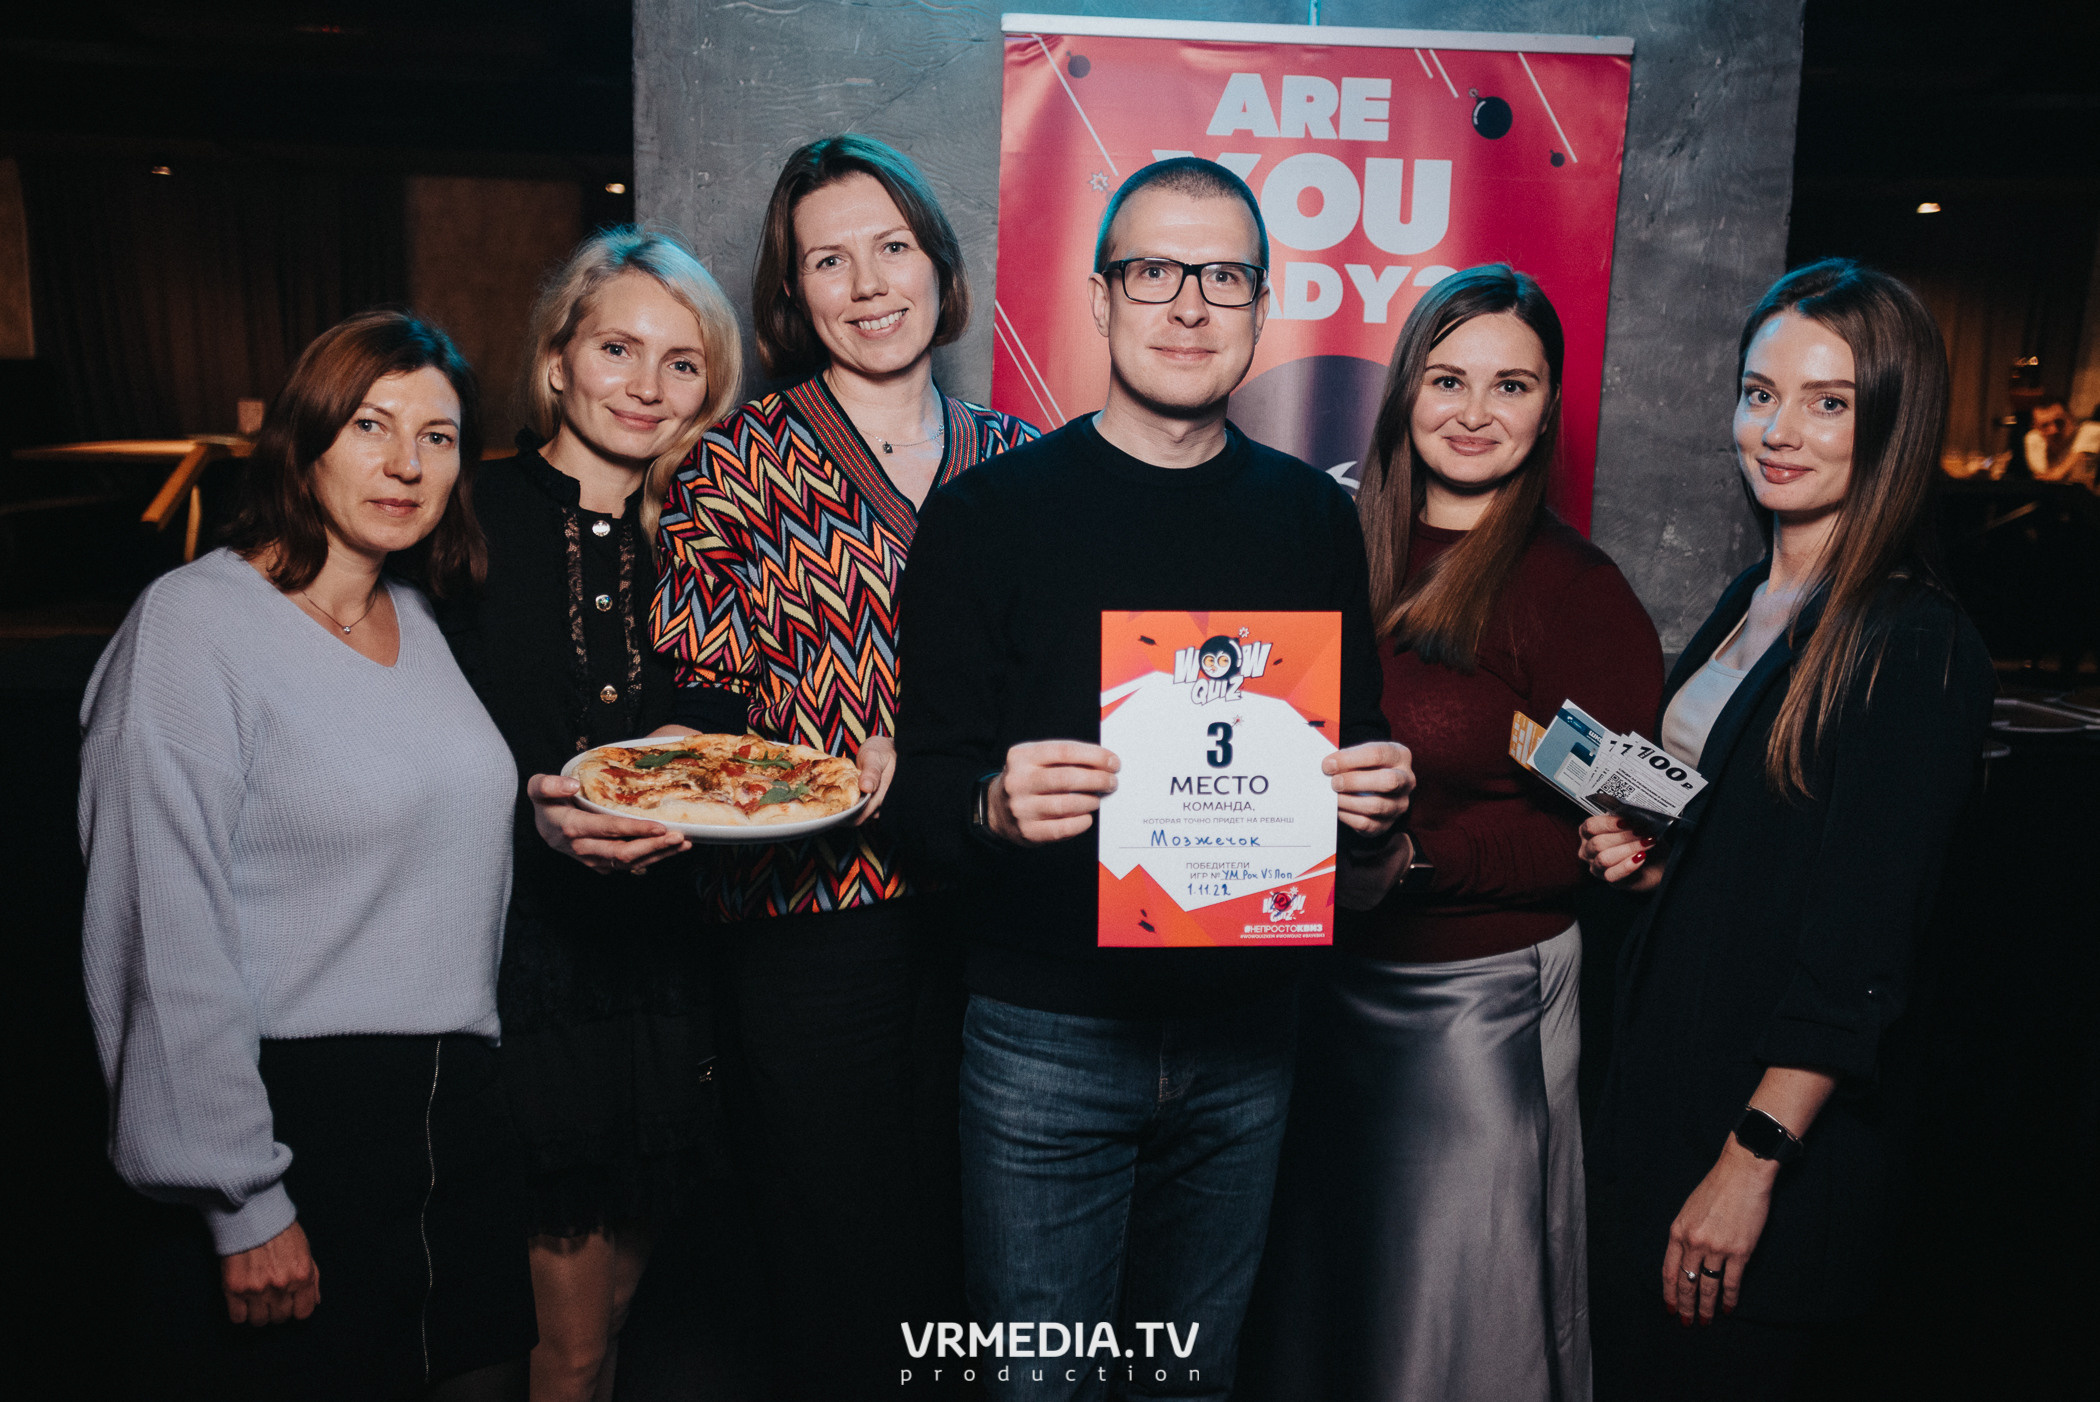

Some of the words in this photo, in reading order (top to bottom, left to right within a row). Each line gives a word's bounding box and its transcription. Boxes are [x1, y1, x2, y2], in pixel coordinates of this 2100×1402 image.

[1206, 73, 1392, 141] ARE
[1191, 675, 1245, 706] QUIZ
[1207, 721, 1233, 769] 3
[1170, 775, 1269, 796] МЕСТО
[1150, 829, 1261, 847] Мозжечок
[1186, 862, 1250, 870] ПОБЕДИТЕЛИ
[1244, 924, 1323, 933] #НЕПРОСТОКВИЗ
